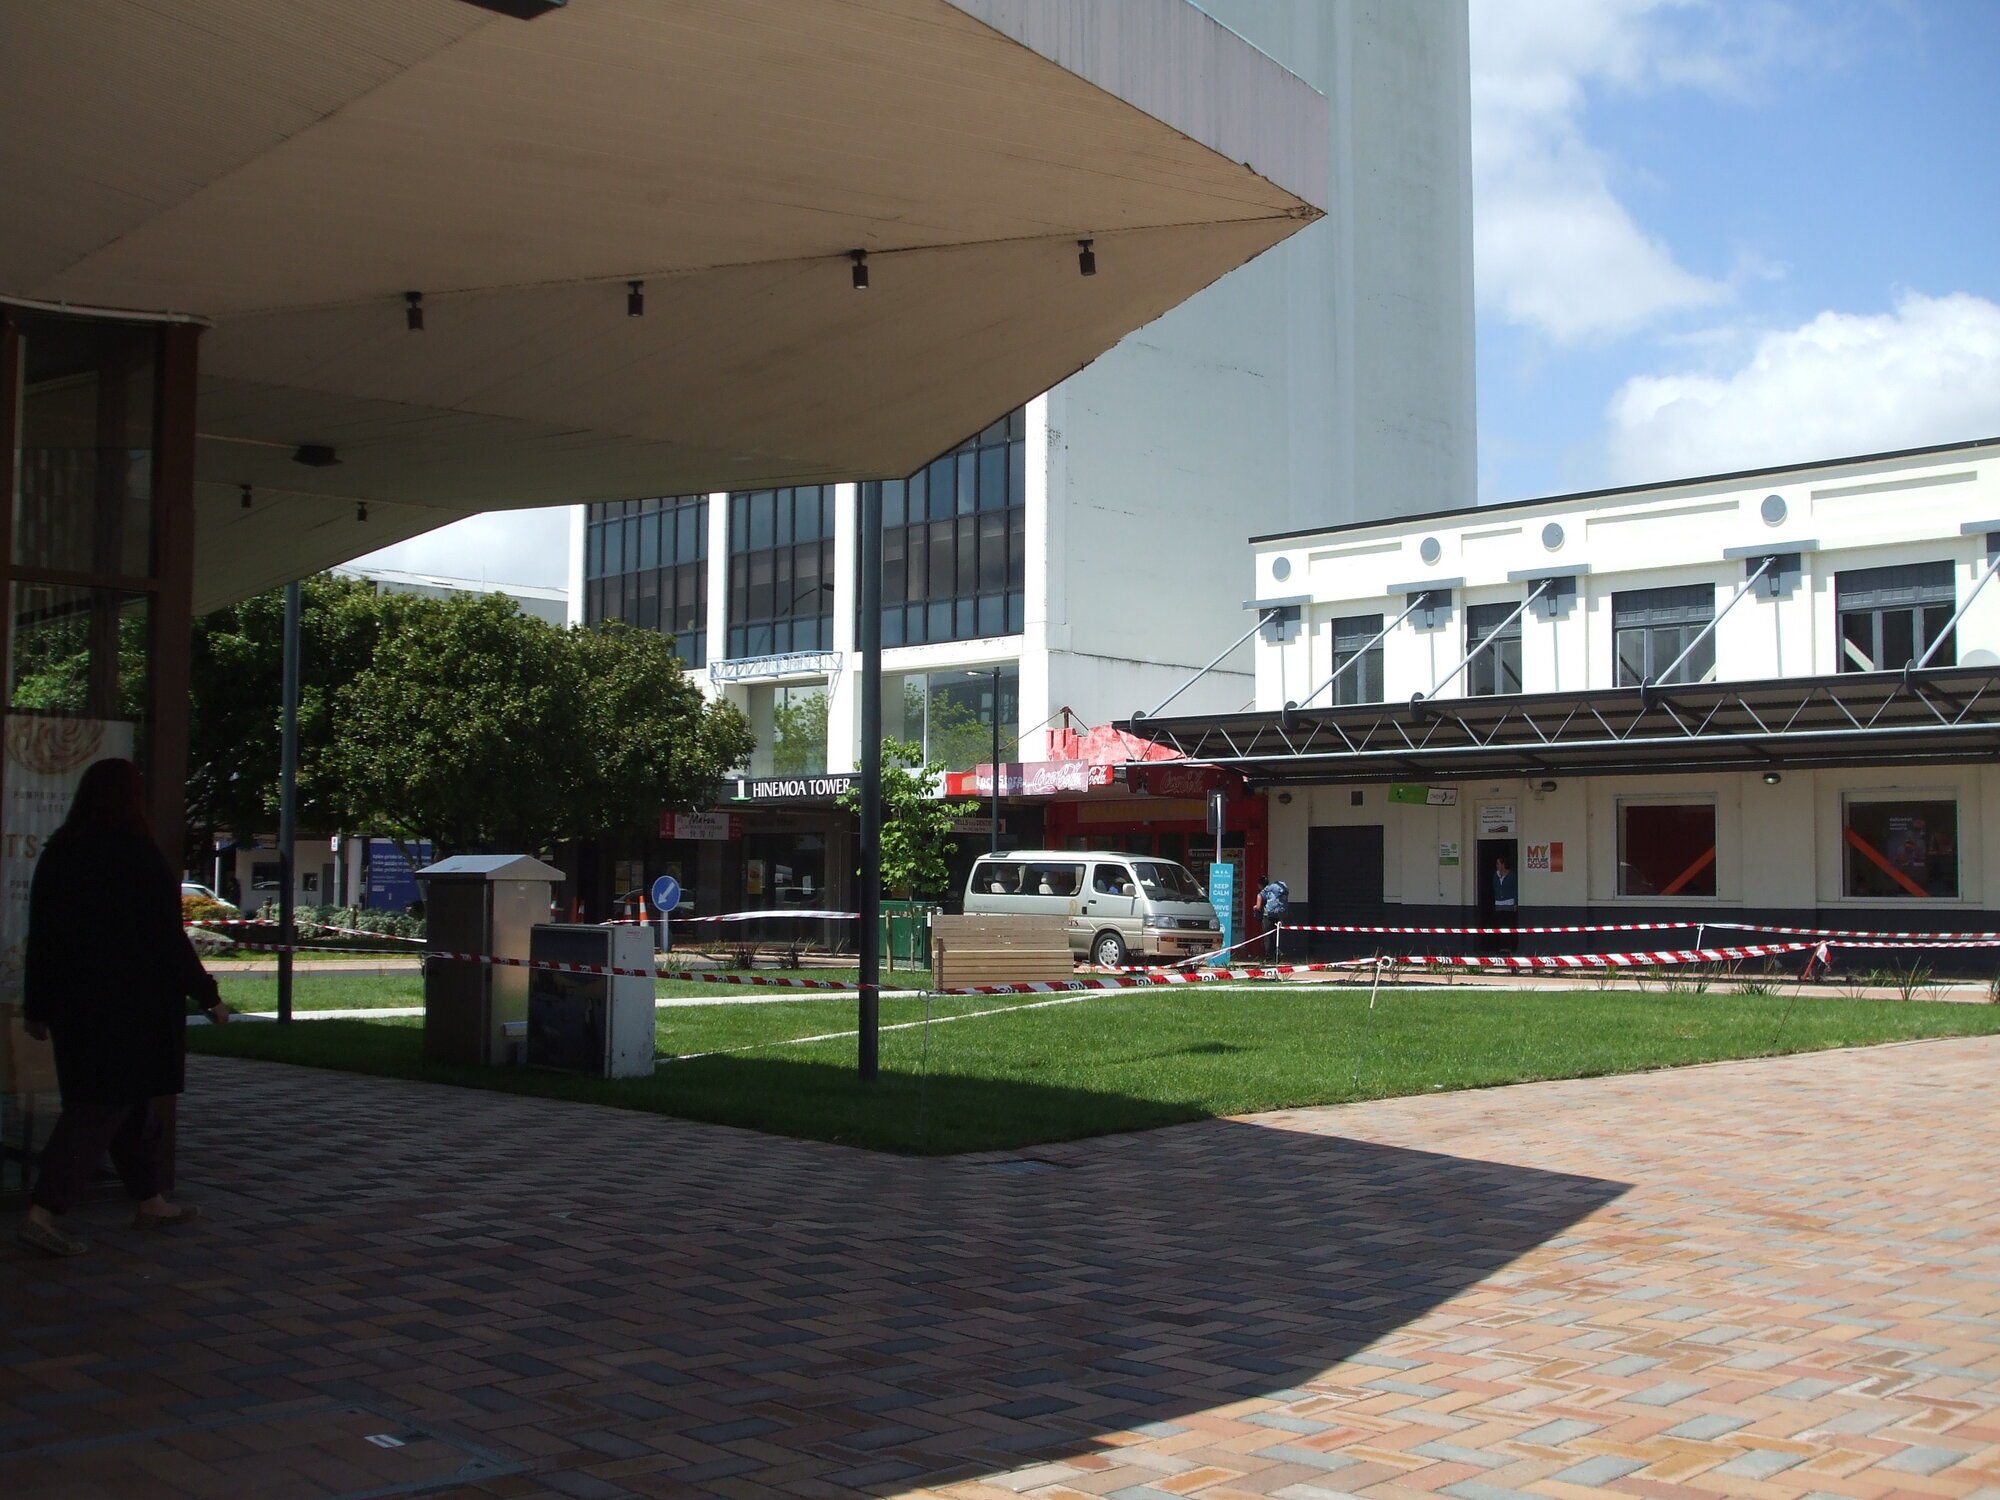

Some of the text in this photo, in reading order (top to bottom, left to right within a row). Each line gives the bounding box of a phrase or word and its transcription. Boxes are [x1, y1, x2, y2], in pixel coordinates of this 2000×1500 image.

[753, 778, 851, 798] HINEMOA TOWER
[1527, 844, 1549, 857] MY
